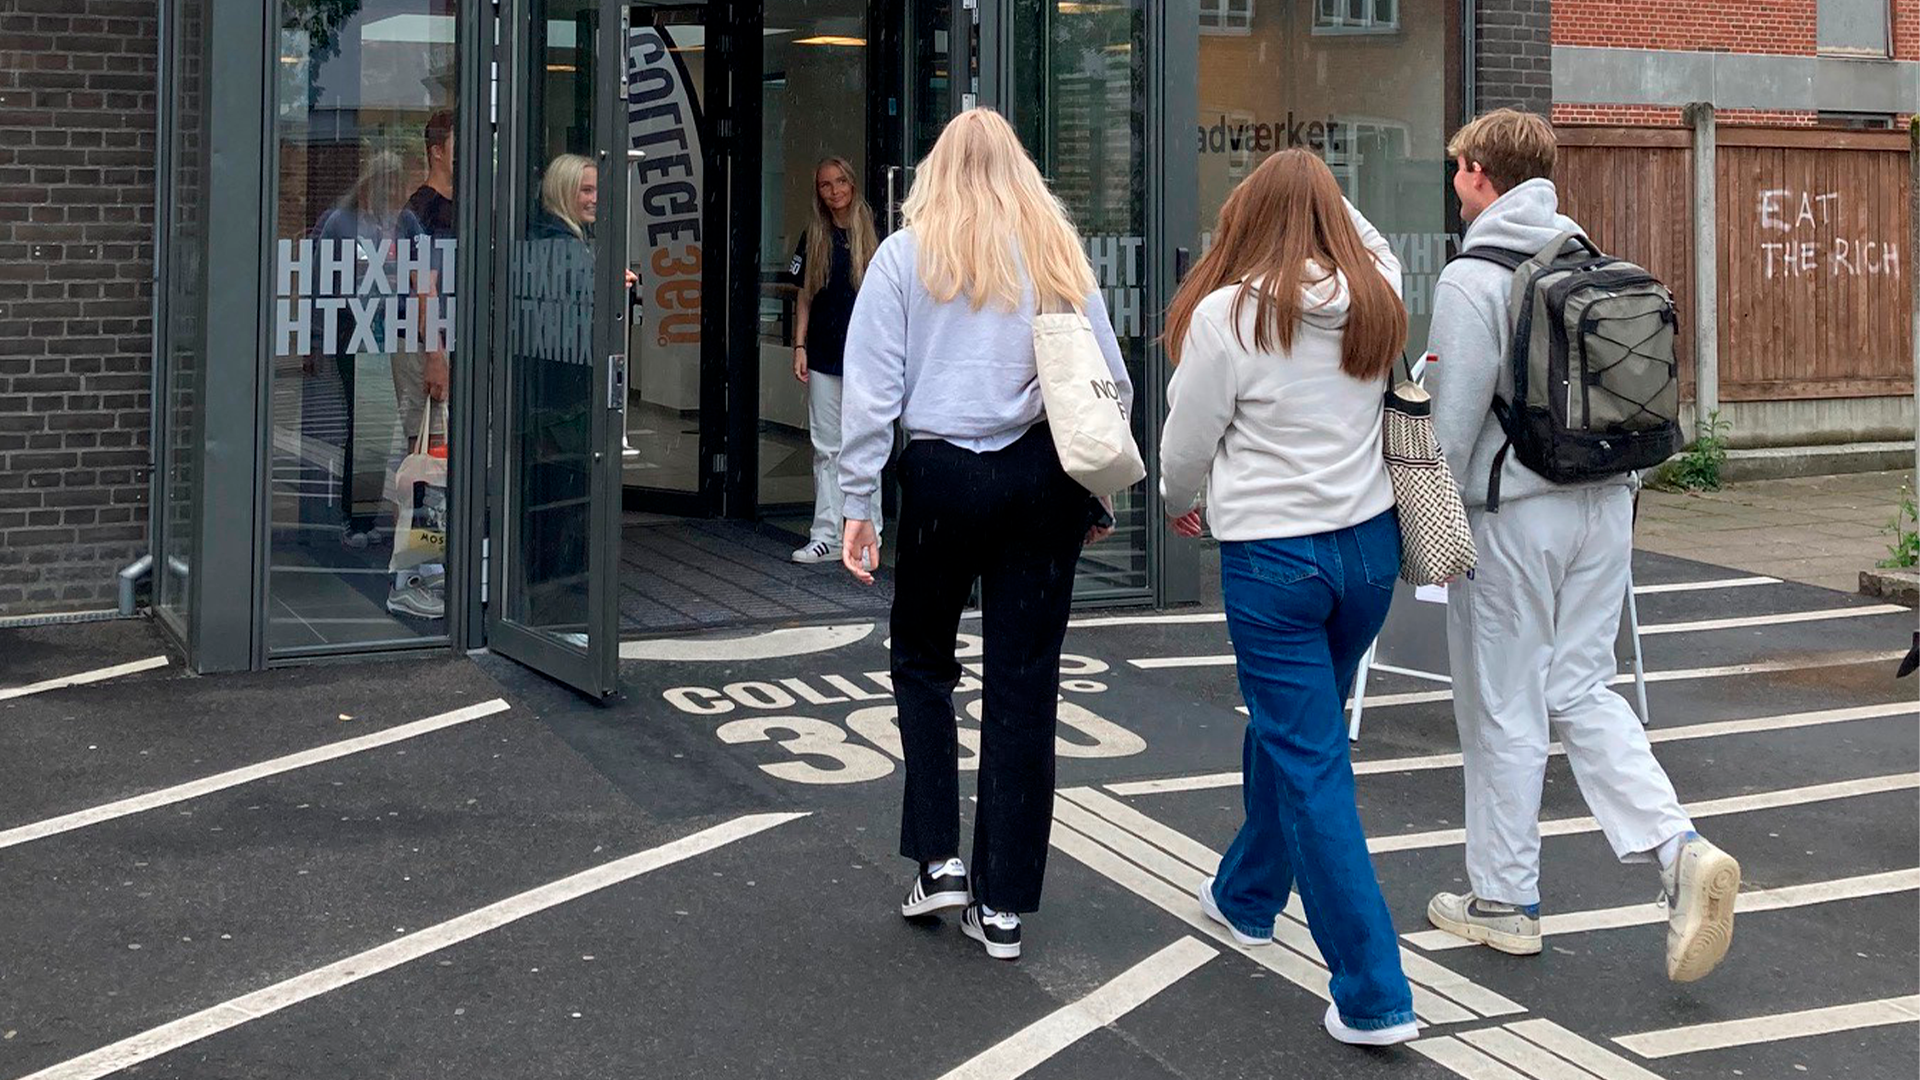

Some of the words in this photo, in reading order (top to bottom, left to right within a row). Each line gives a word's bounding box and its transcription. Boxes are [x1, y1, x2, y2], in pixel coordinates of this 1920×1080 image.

[1759, 189, 1838, 232] EAT
[277, 238, 457, 296] HHXHT
[1761, 239, 1818, 279] THE
[1833, 238, 1900, 279] RICH
[275, 297, 457, 356] HTXHH
